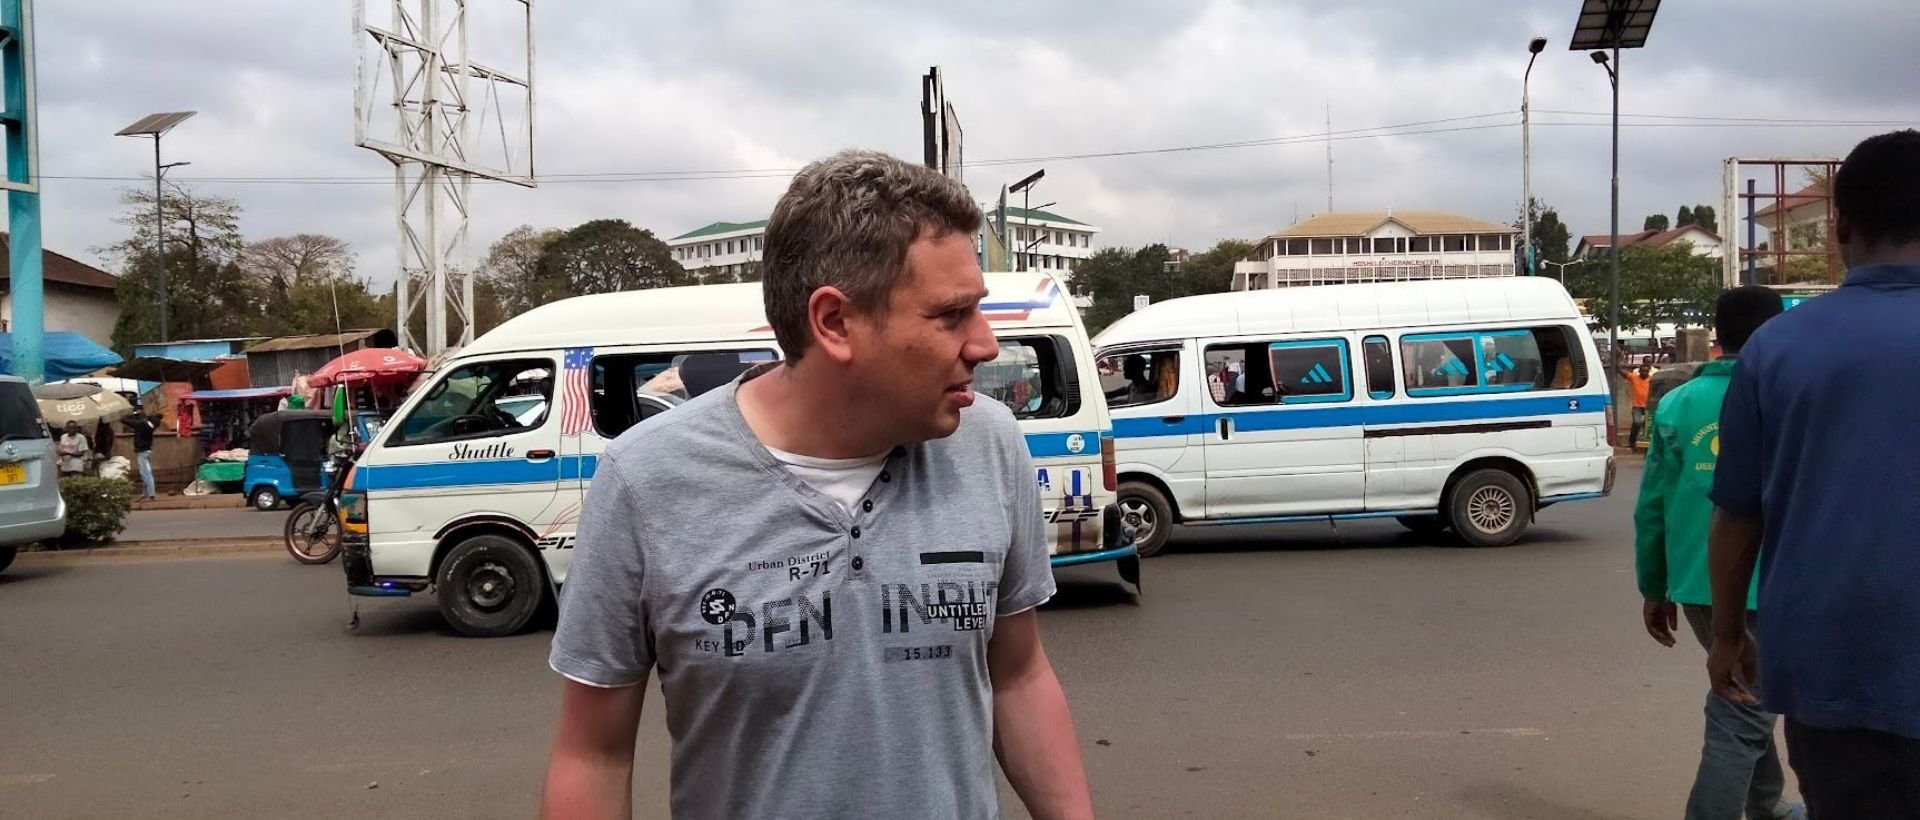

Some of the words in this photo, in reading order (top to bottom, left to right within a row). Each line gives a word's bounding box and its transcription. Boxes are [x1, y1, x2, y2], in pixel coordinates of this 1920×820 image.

[56, 400, 86, 416] tigo
[448, 441, 516, 460] Shuttle
[747, 559, 784, 571] Urban
[788, 550, 830, 566] District
[789, 560, 831, 581] R-71
[904, 645, 952, 661] 15.133
